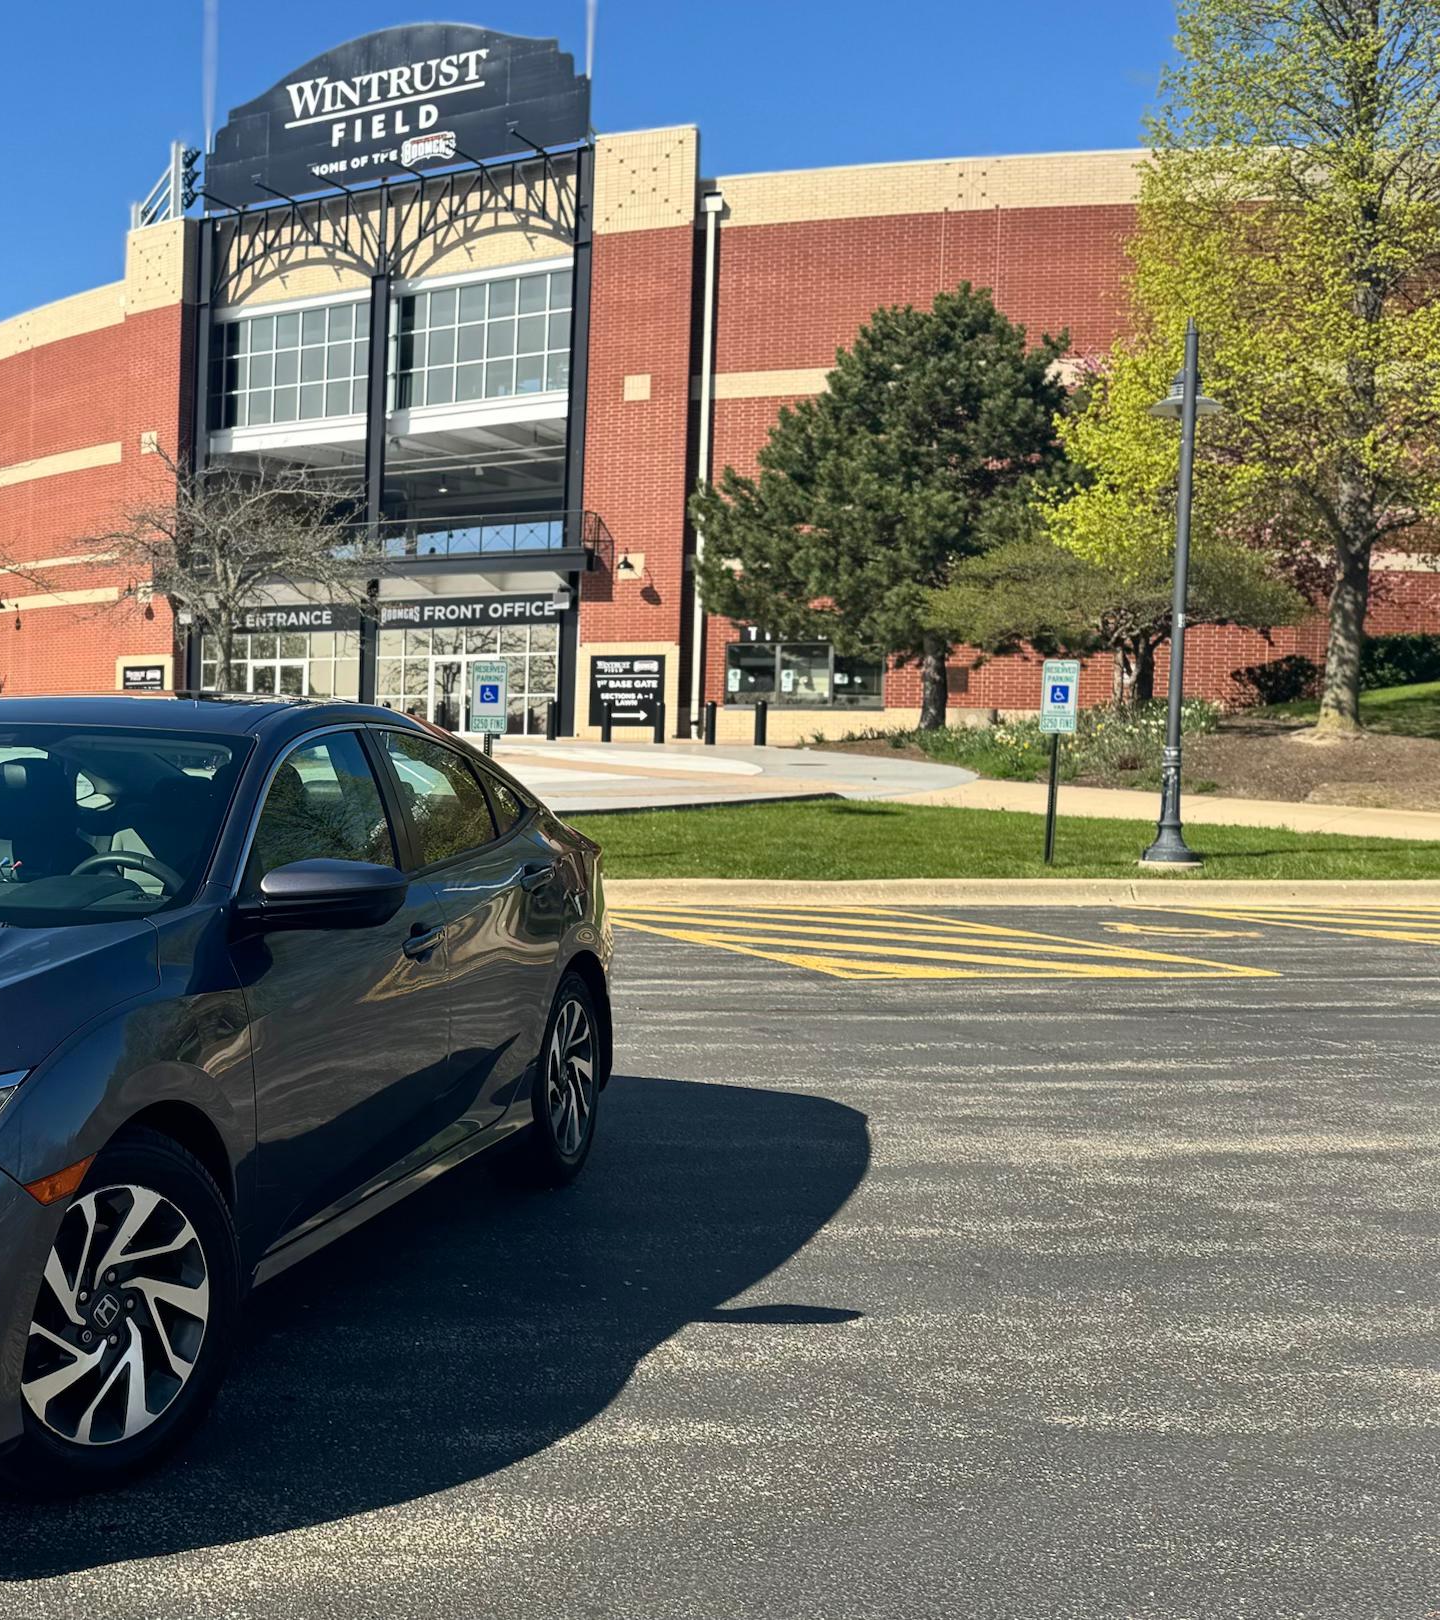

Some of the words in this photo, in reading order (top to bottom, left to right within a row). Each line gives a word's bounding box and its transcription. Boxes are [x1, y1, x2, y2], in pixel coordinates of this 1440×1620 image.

[286, 49, 489, 119] WINTRUST
[332, 104, 439, 147] FIELD
[350, 156, 369, 169] OF
[381, 605, 420, 624] BOOMERS
[423, 604, 484, 621] FRONT
[488, 600, 555, 618] OFFICE
[245, 610, 333, 628] ENTRANCE
[475, 665, 506, 673] RESERVED
[476, 674, 503, 682] PARKING
[608, 680, 633, 688] BASE
[633, 680, 659, 688] GATE
[473, 718, 488, 729] $250
[490, 718, 504, 729] FINE
[1059, 718, 1073, 729] FINE
